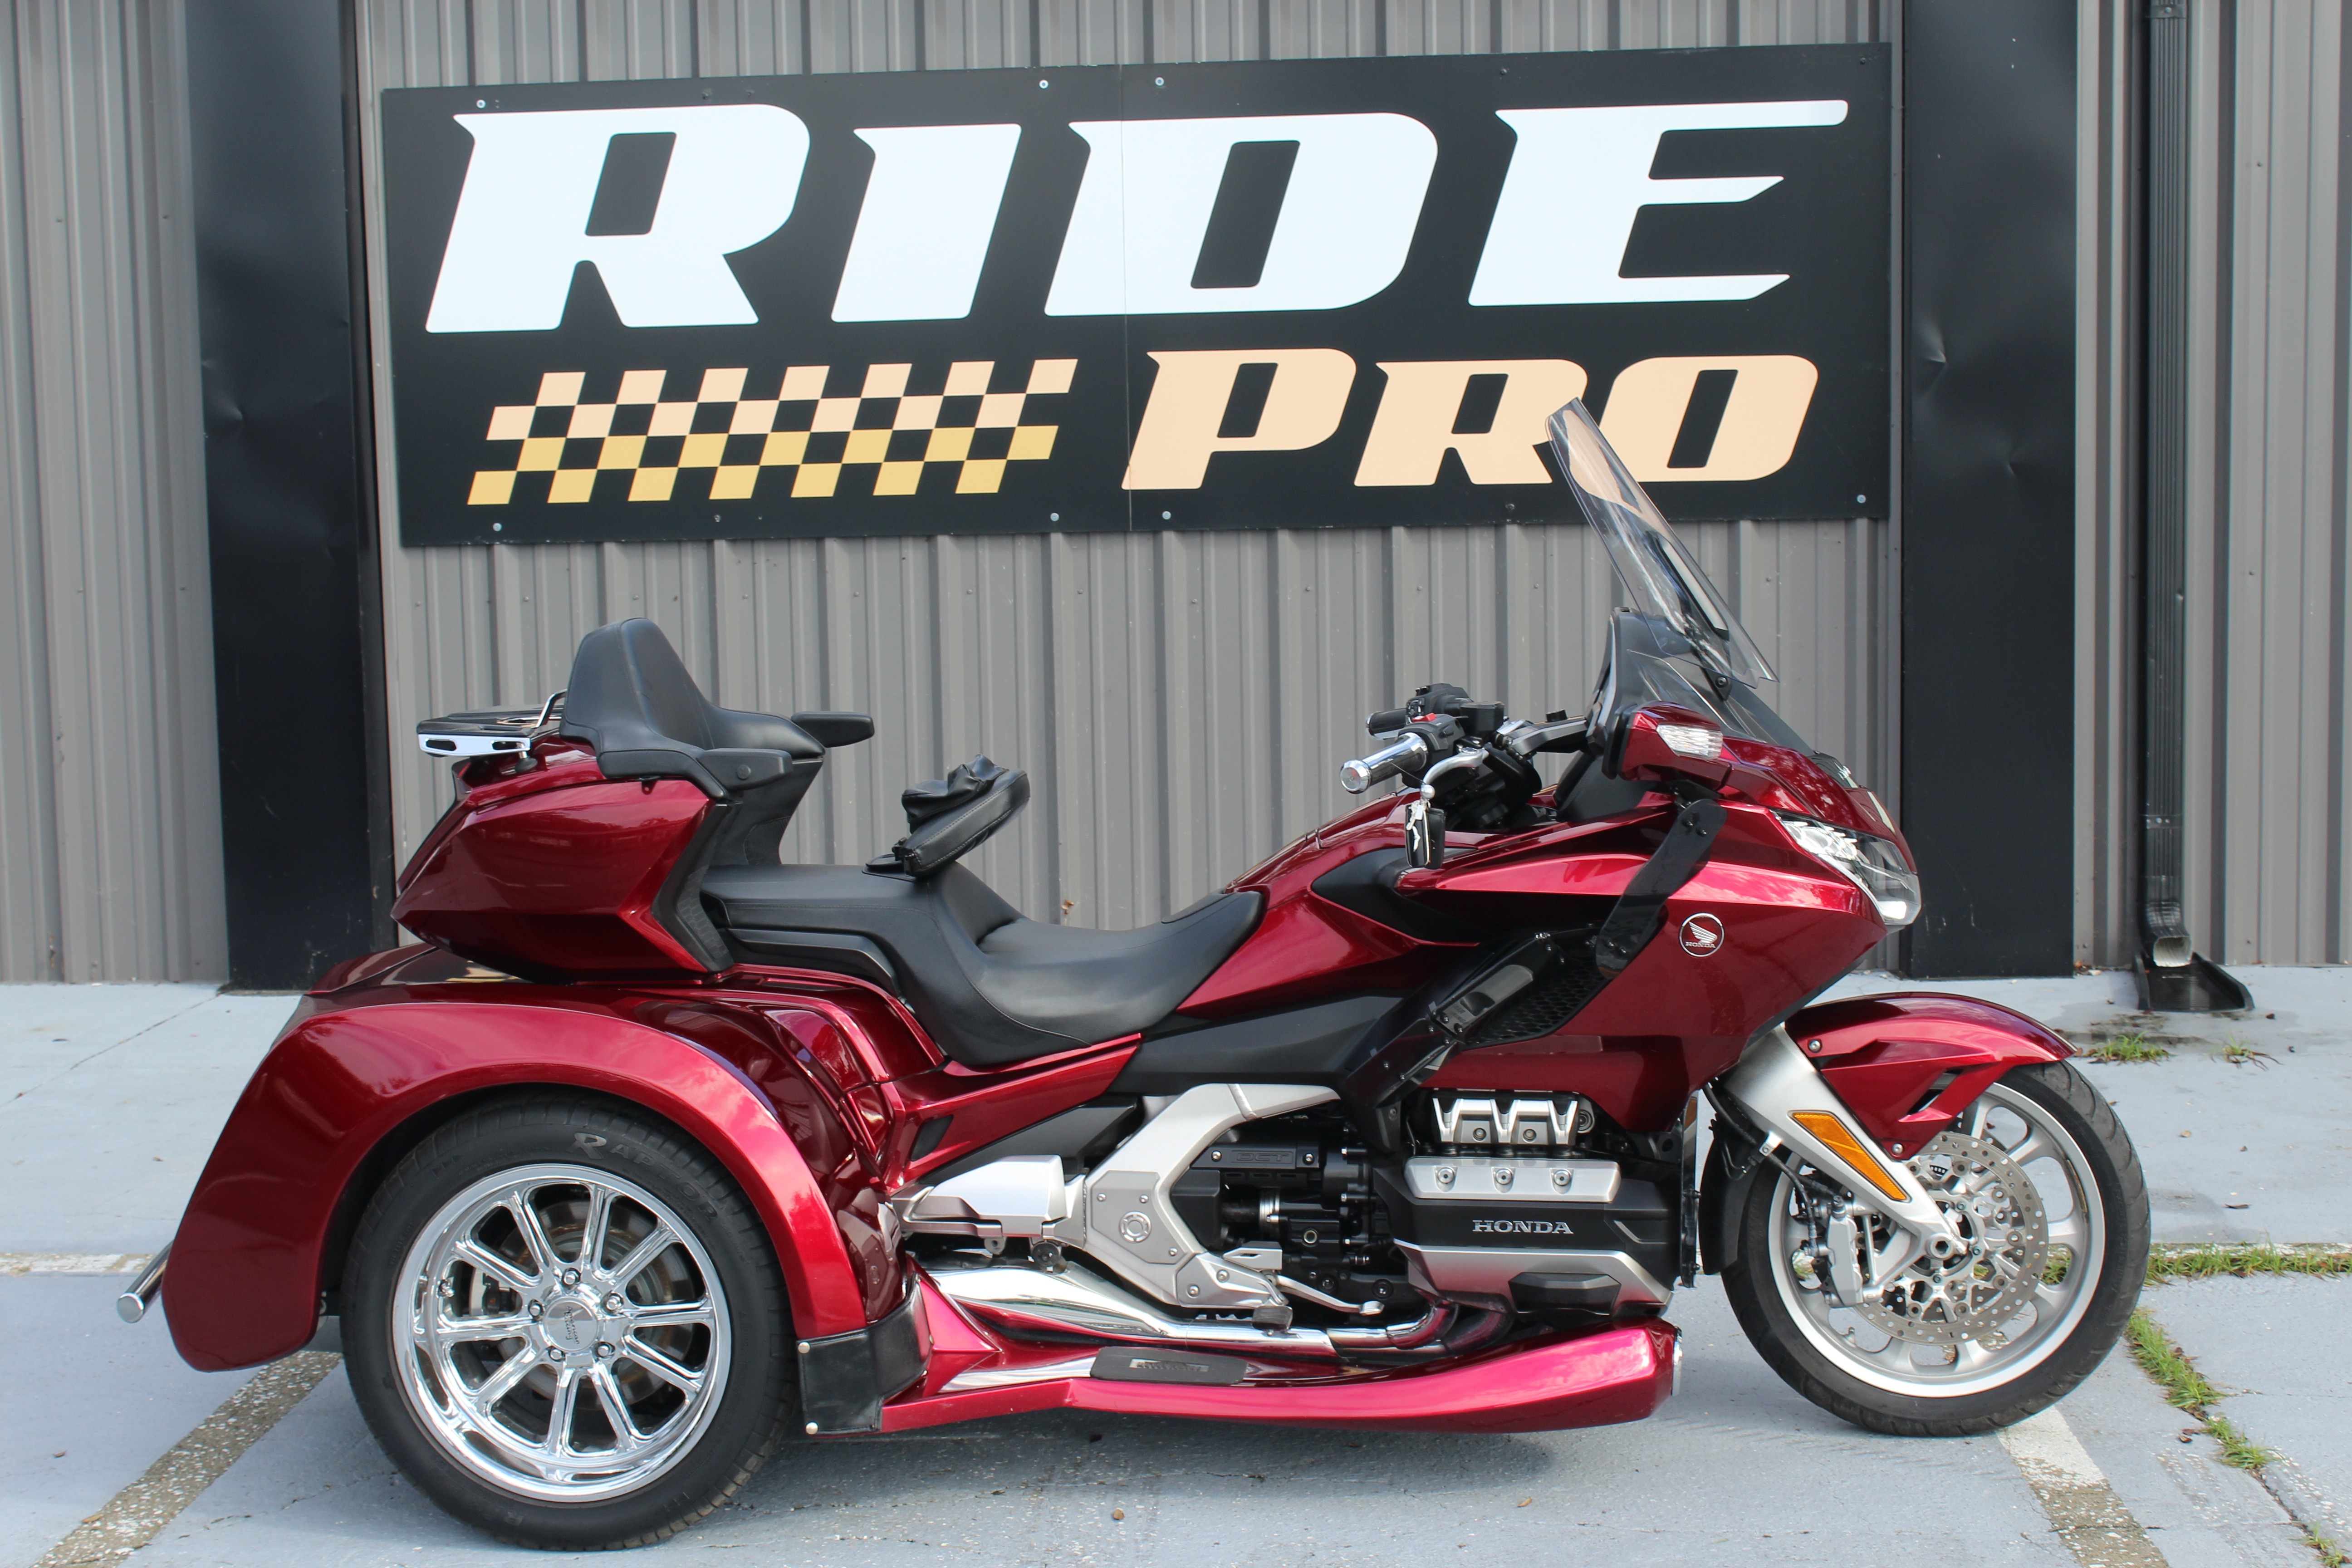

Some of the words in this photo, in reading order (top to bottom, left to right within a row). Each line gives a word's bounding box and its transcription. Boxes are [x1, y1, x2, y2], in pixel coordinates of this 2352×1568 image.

[426, 100, 1848, 333] RIDE
[1122, 349, 1818, 490] PRO
[565, 1132, 718, 1222] RAPTOR
[1237, 1152, 1289, 1161] DCT
[1472, 1220, 1574, 1235] HONDA
[567, 1306, 579, 1344] American
